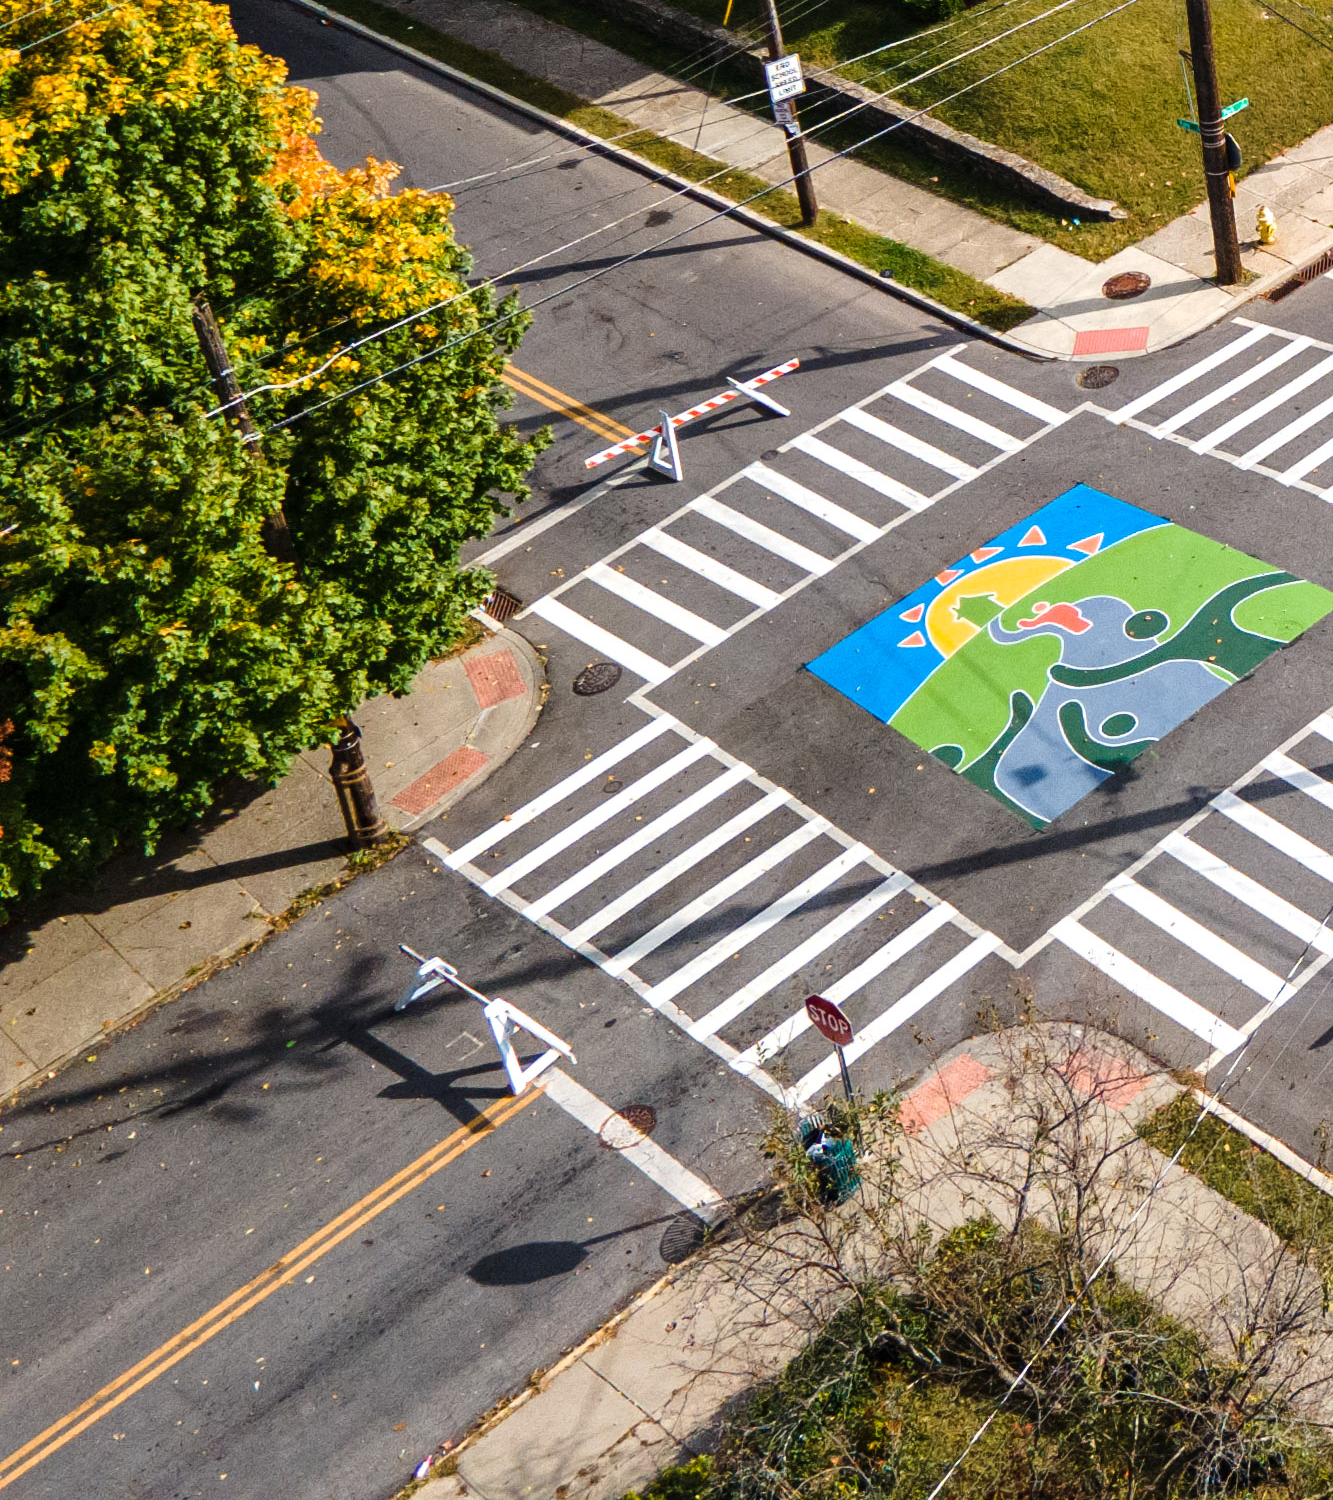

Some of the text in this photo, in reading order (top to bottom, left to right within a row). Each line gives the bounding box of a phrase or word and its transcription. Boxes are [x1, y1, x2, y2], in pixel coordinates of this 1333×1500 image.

[776, 61, 790, 71] END
[771, 67, 797, 81] SCHOOL
[779, 84, 797, 96] LIMIT
[808, 1004, 849, 1035] STOP
